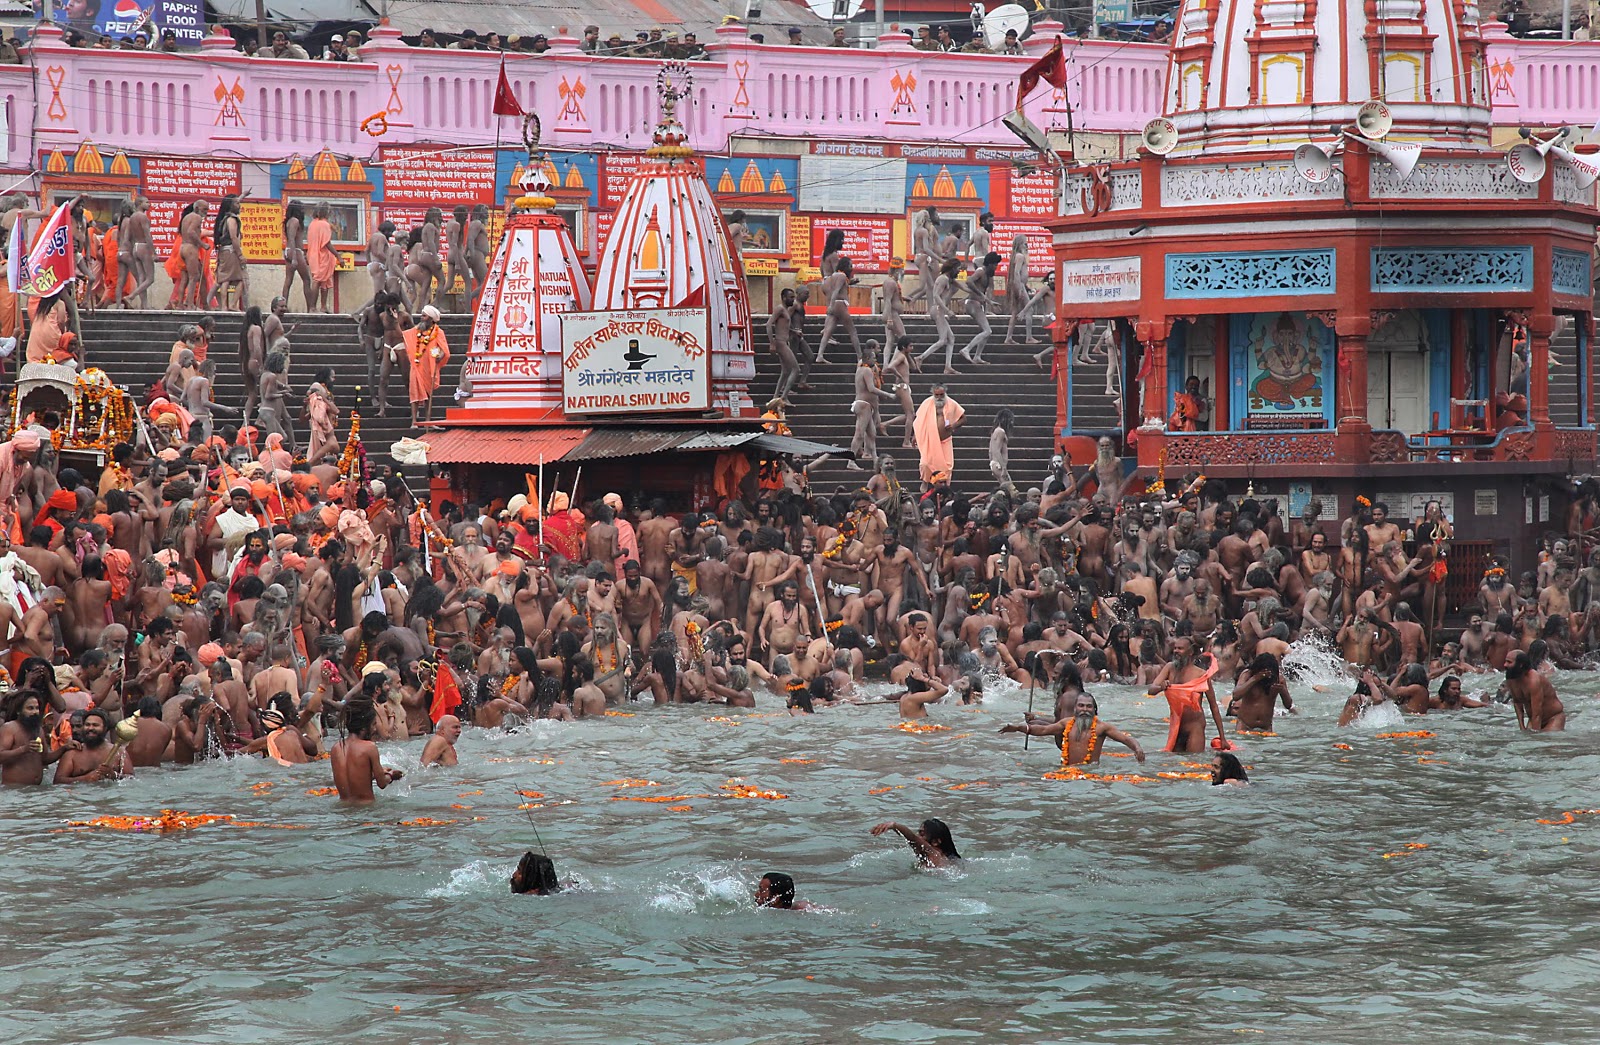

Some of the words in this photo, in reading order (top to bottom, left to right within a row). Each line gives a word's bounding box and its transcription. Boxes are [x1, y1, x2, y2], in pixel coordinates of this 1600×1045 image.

[162, 2, 198, 14] PAPPU
[166, 15, 196, 26] FOOD
[1104, 10, 1124, 21] ATM
[828, 144, 847, 156] गंगा
[511, 256, 529, 274] श्री
[507, 274, 532, 292] हरि
[540, 272, 569, 283] NATUAL
[504, 291, 533, 305] चरण
[540, 286, 572, 297] VISHNU
[542, 302, 566, 314] FEET
[496, 329, 535, 351] मन्दिर
[564, 336, 597, 372] प्राचीन
[646, 318, 671, 338] शिव
[668, 328, 705, 361] मन्दिर
[492, 355, 542, 376] मन्दिर
[578, 369, 595, 387] श्री
[596, 368, 641, 387] गंगेश्वर
[644, 365, 695, 386] महादेव
[567, 394, 628, 409] NATURAL
[629, 393, 657, 406] SHIV
[660, 392, 690, 405] LING
